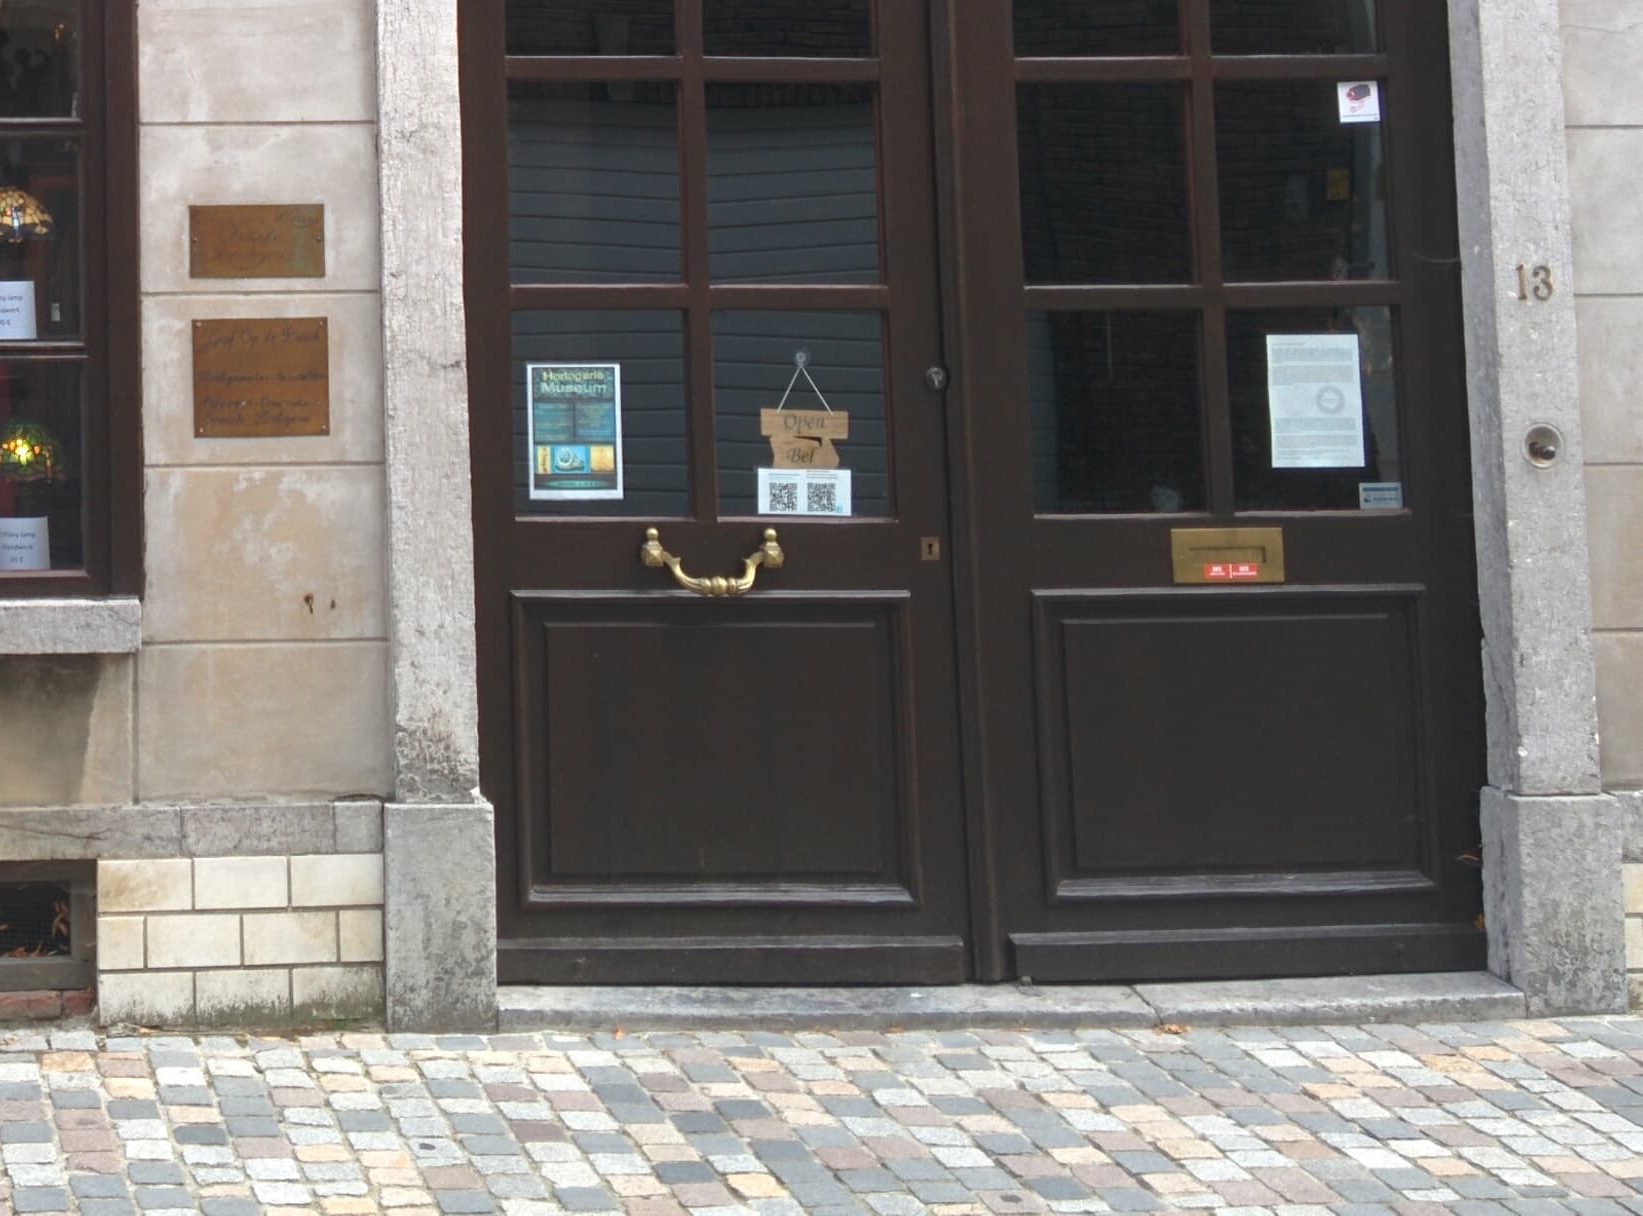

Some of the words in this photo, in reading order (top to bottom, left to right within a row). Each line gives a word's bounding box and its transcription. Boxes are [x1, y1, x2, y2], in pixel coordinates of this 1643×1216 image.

[1515, 263, 1554, 301] 13
[540, 382, 607, 393] Museum
[783, 414, 825, 434] Open
[787, 447, 817, 464] Bel
